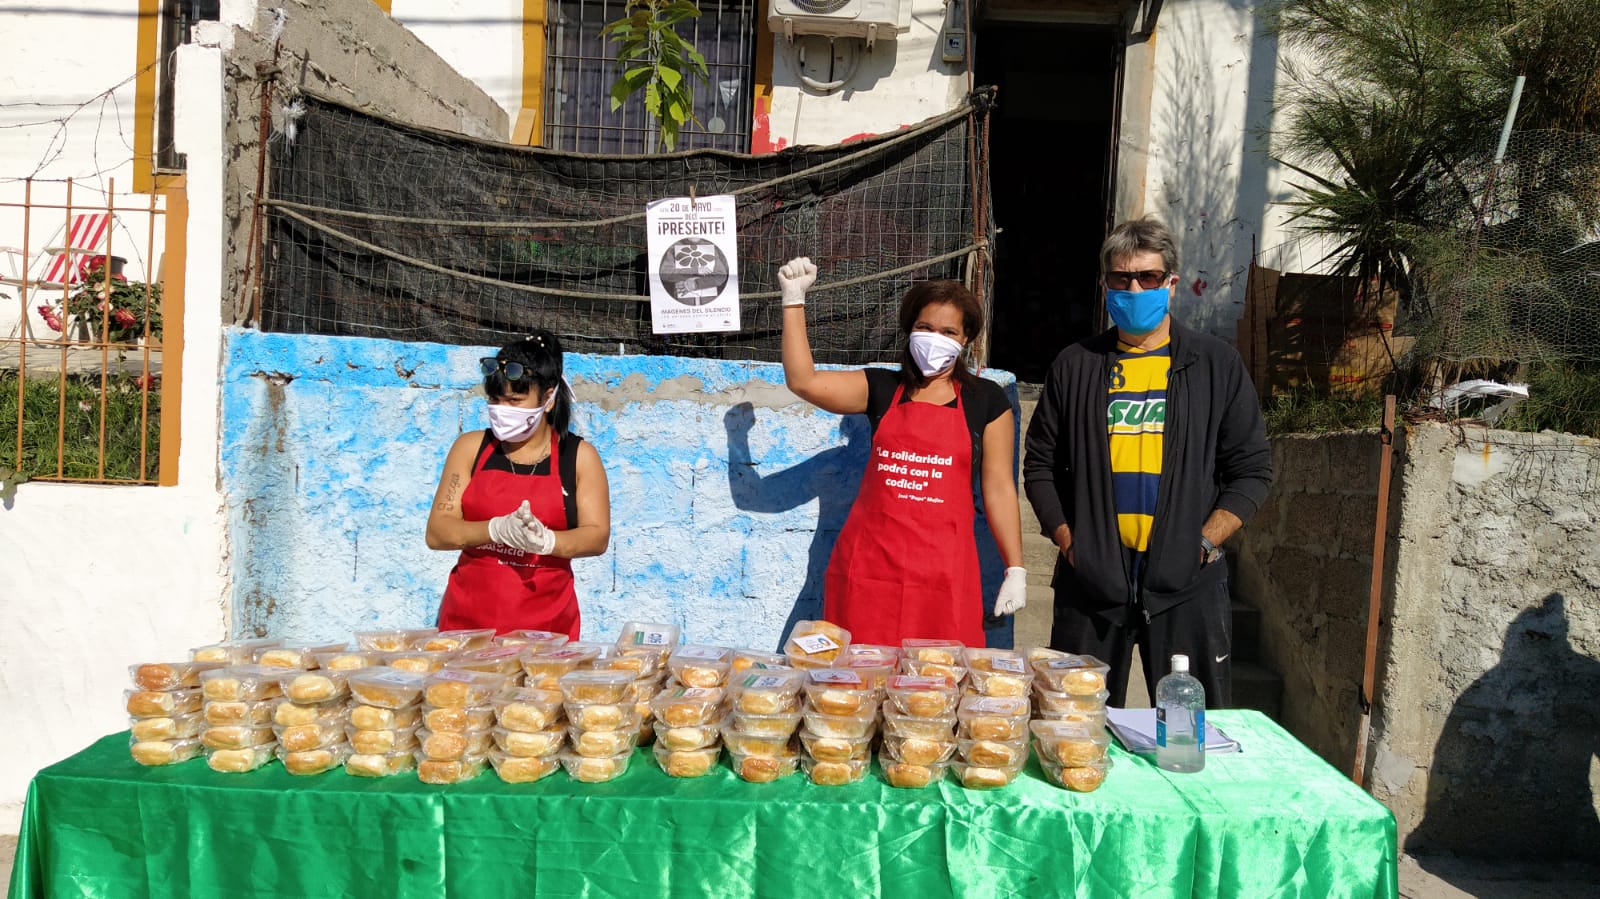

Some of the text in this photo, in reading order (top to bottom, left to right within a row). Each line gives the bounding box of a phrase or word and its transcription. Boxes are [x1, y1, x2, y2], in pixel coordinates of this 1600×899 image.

[670, 203, 680, 212] 20
[691, 202, 712, 212] MAYO
[658, 221, 725, 235] ¡PRESENTE!
[891, 451, 953, 466] solidaridad
[877, 462, 943, 479] podrá con la
